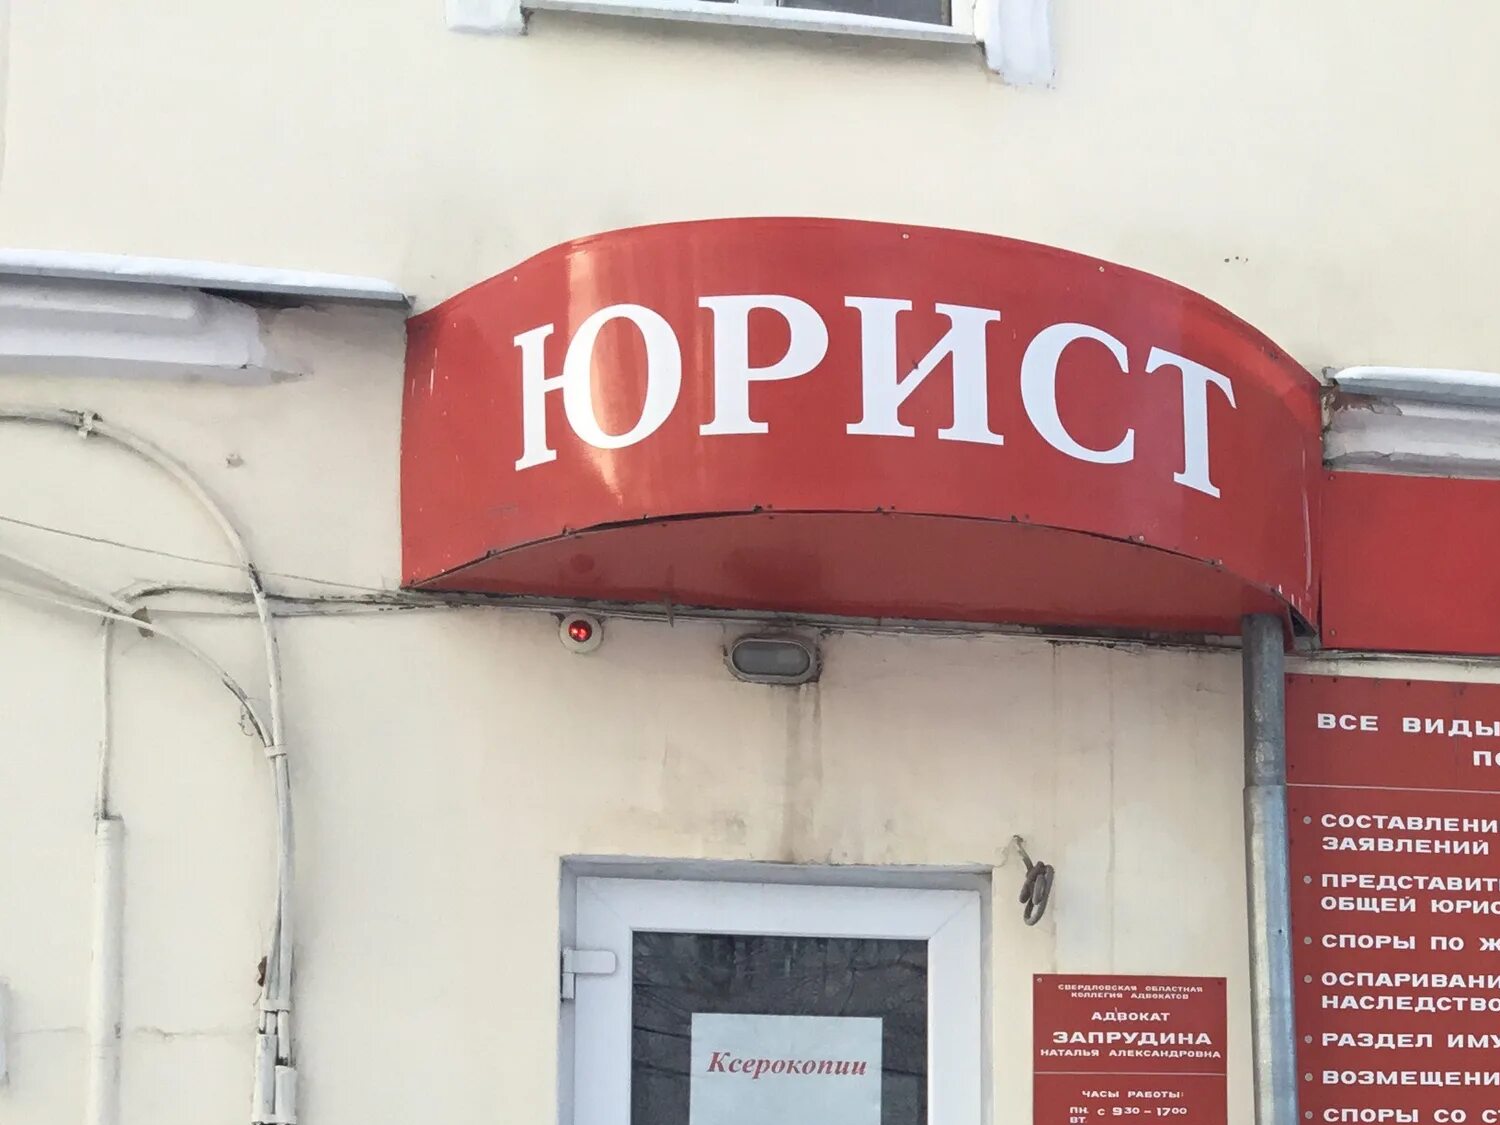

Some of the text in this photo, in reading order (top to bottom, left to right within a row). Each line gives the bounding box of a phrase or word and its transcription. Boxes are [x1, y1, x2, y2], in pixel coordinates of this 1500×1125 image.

[513, 293, 1237, 499] ЮРИСТ
[1318, 713, 1378, 731] ВСЕ
[1403, 718, 1500, 737] ВИДЫ
[1323, 837, 1488, 855] ЗАЯВЛЕНИЙ
[1321, 897, 1416, 913] ОБЩЕЙ
[1322, 935, 1415, 949] СПОРЫ
[1431, 937, 1464, 950] ПО
[1092, 1012, 1171, 1022] АДВОКАТ
[1053, 1032, 1211, 1046] ЗАПРУДИНА
[1323, 1033, 1432, 1049] РАЗДЕЛ
[1109, 1050, 1220, 1058] АЛЕКСАНДРОВНА
[706, 1052, 867, 1079] Ксерокопии
[1324, 1109, 1418, 1122] СПОРЫ
[1434, 1109, 1466, 1122] СО
